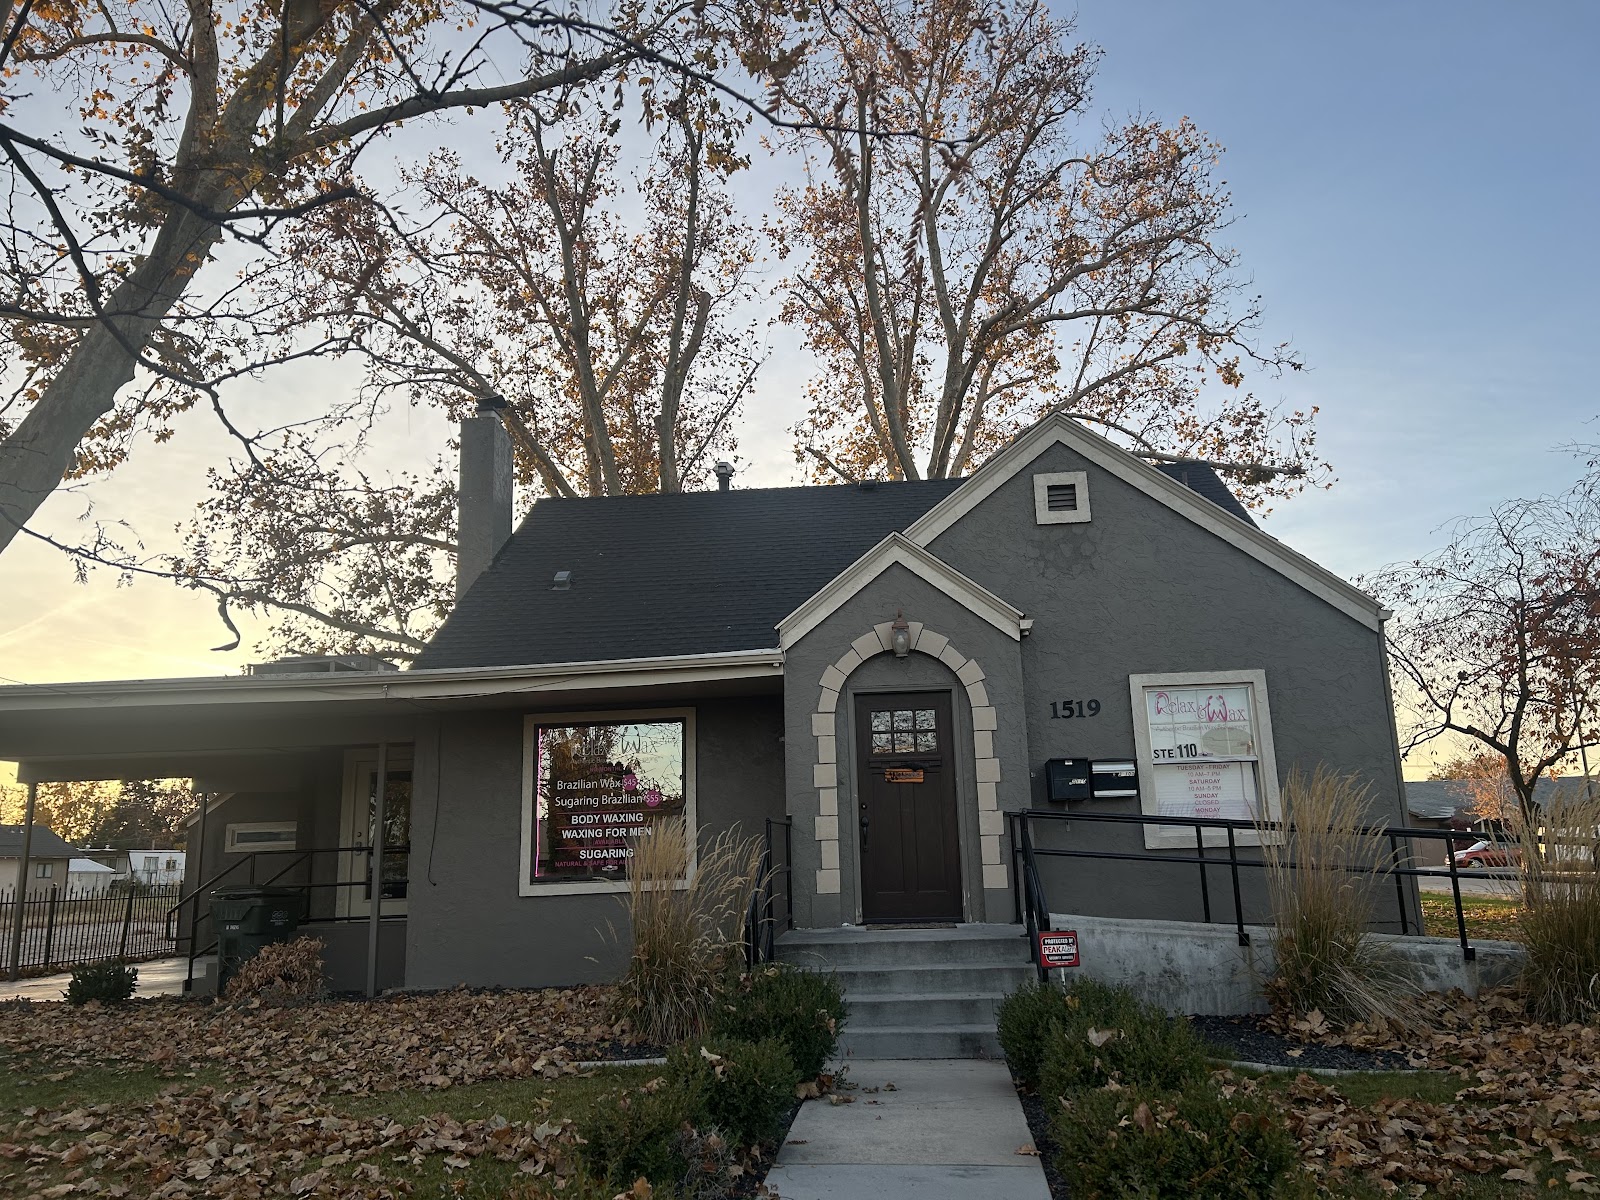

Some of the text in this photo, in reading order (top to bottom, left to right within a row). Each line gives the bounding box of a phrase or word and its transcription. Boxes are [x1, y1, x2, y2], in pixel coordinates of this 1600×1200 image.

[1050, 699, 1101, 719] 1519
[1155, 692, 1196, 715] Relax
[1207, 695, 1246, 722] Wax
[1153, 743, 1197, 759] STE 110
[557, 778, 598, 790] Brazilian
[624, 779, 637, 787] $45
[555, 793, 659, 809] Sugaring Brazilian $55
[571, 813, 644, 825] BODY WAXING
[562, 826, 652, 839] WAXING FOR MEN
[579, 848, 634, 860] SUGARING
